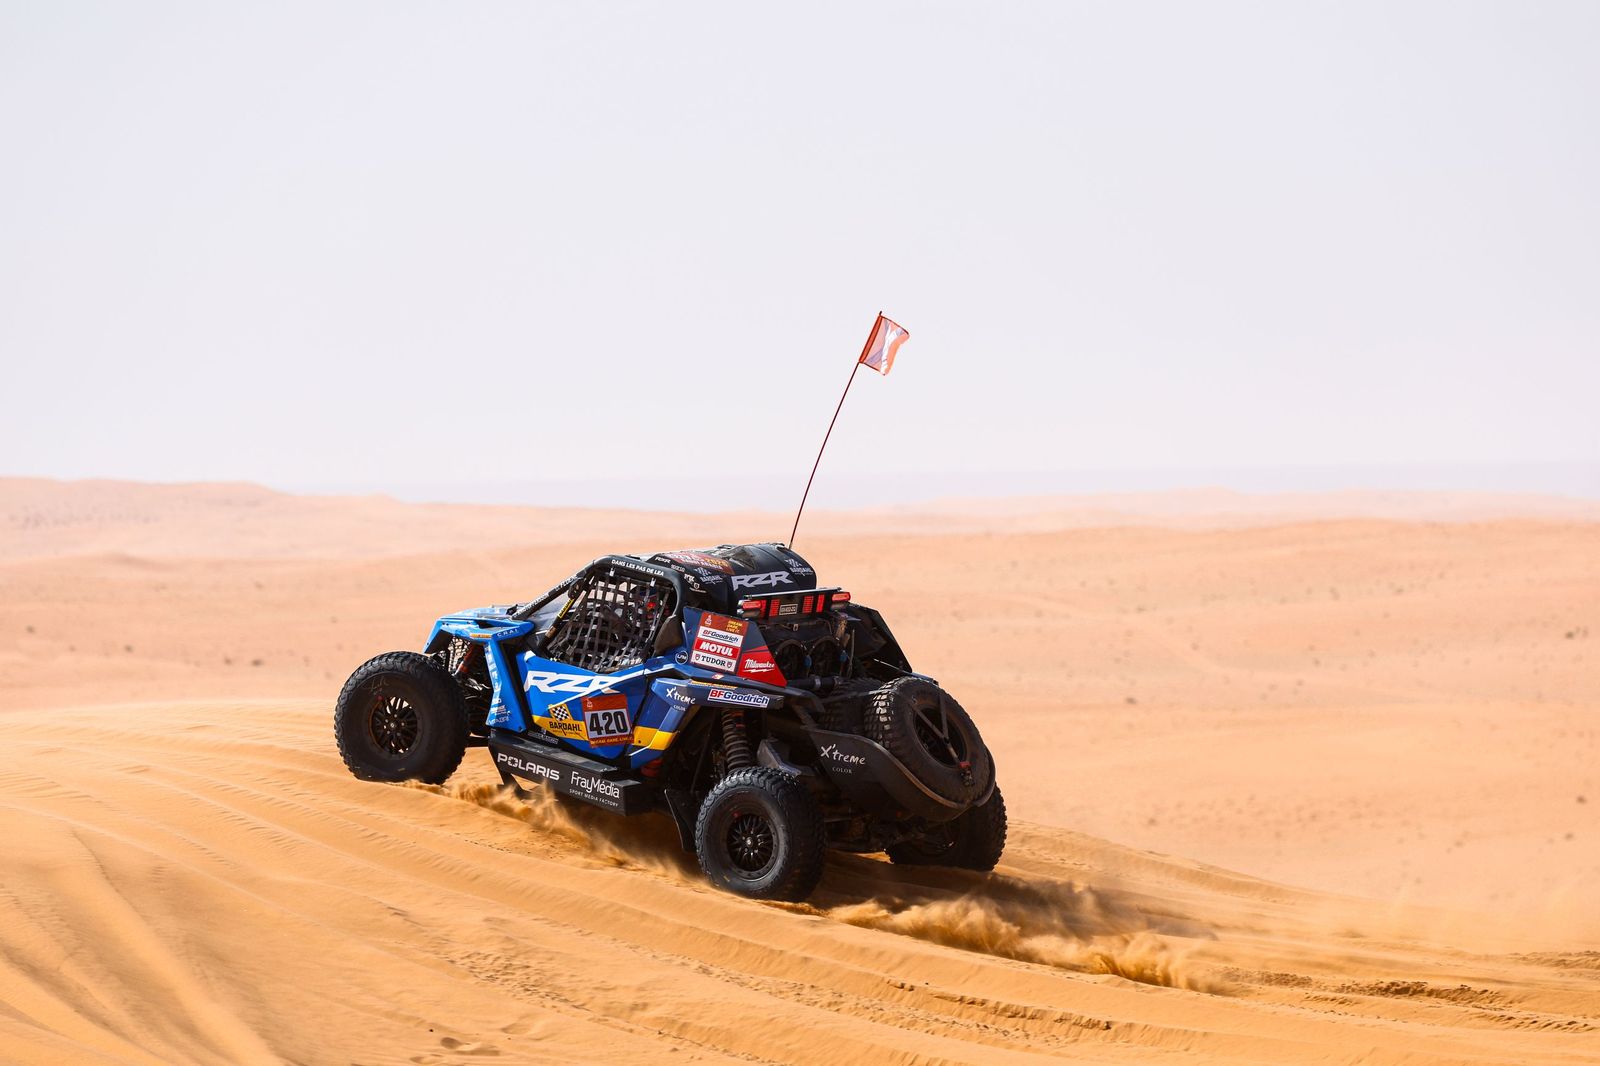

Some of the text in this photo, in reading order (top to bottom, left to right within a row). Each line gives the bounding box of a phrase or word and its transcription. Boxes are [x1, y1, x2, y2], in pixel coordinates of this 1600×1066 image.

[611, 559, 625, 567] DANS
[654, 569, 664, 577] LEA
[731, 570, 794, 591] RZR
[702, 629, 739, 642] BFGoodrich
[700, 641, 733, 656] MOTUL
[701, 655, 726, 667] TUDOR
[744, 658, 775, 670] Milwaukee
[524, 670, 621, 693] RZR
[709, 689, 769, 705] BFGoodrich
[549, 721, 582, 734] BARDAHL
[589, 710, 629, 736] 420
[497, 752, 560, 781] POLARIS
[832, 766, 853, 774] COLOR
[570, 771, 620, 799] FrayMédia
[569, 788, 619, 807] SPORT MEDIA FACTORY
